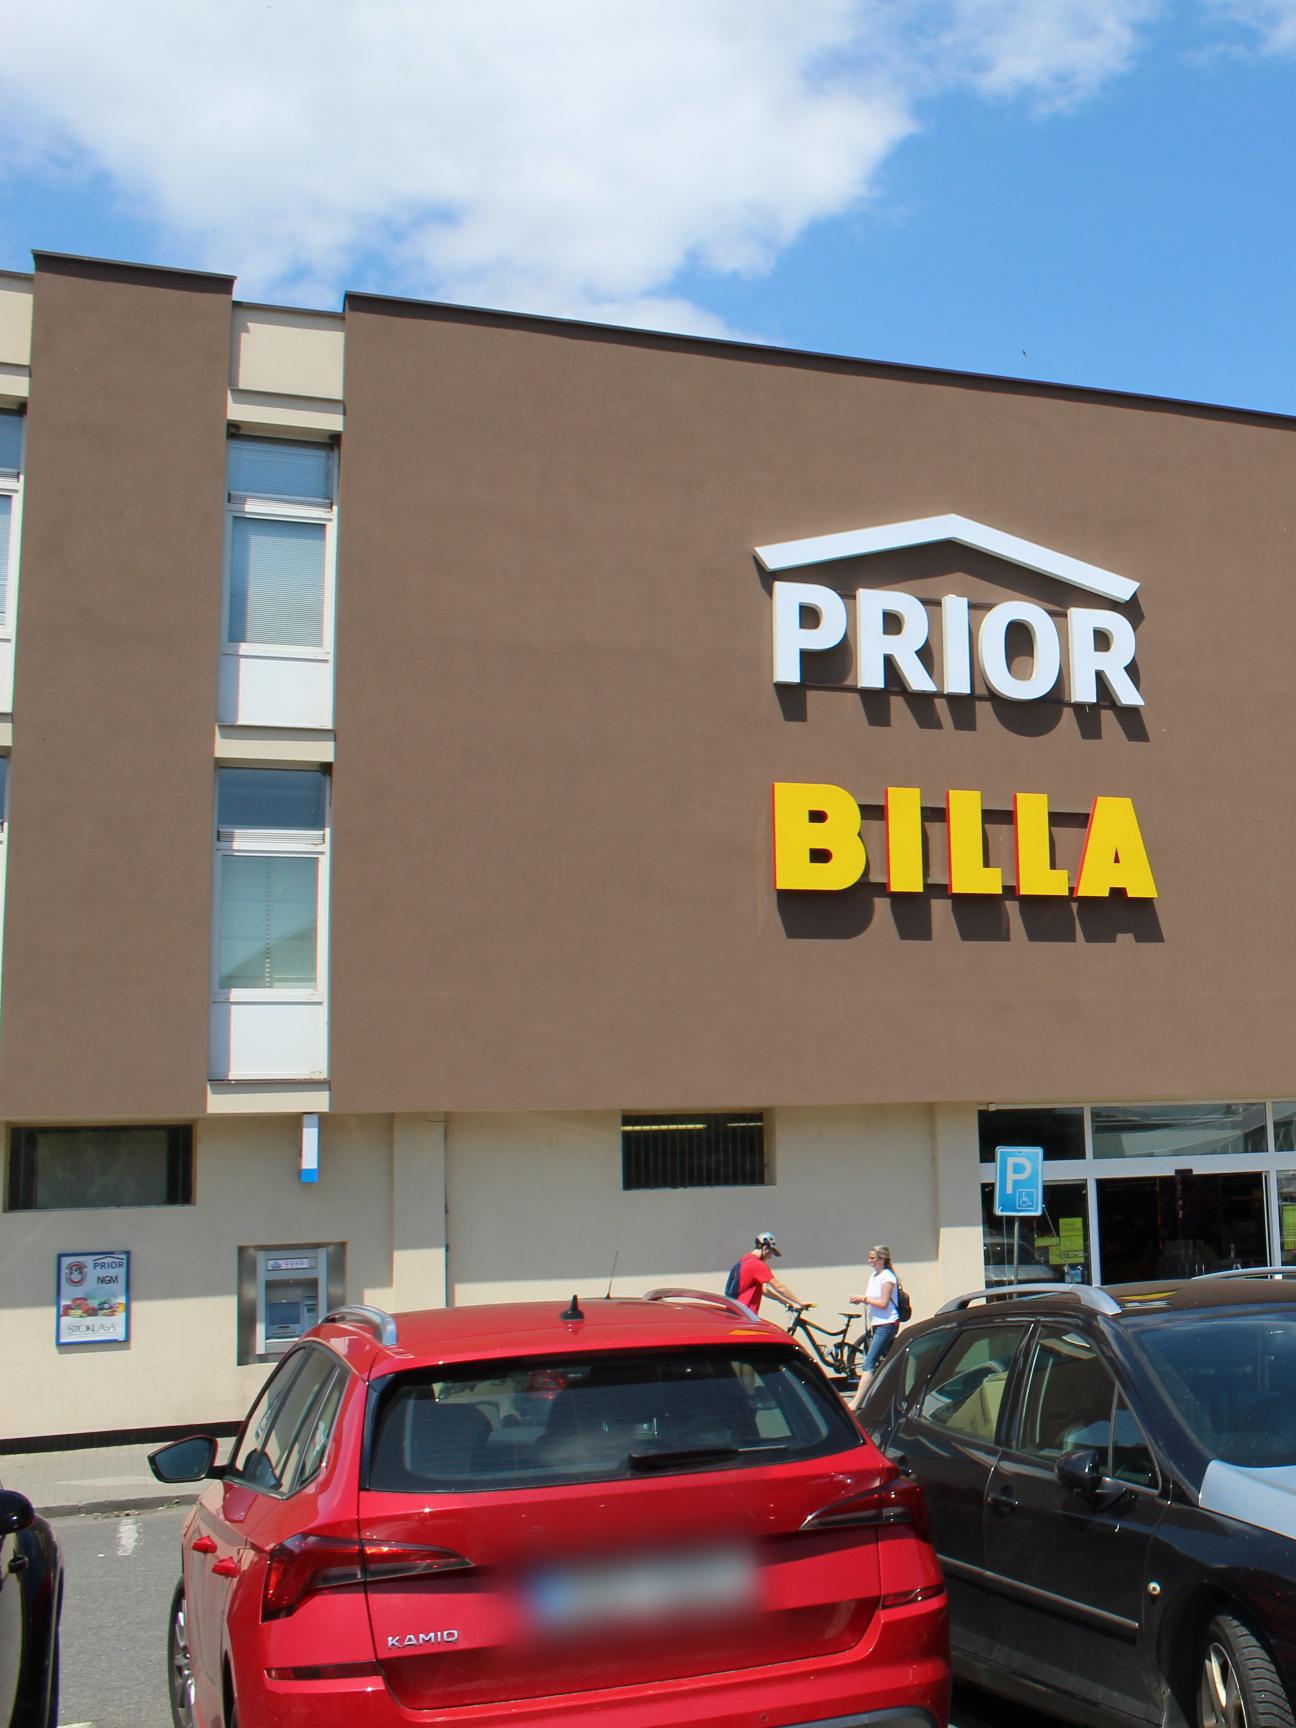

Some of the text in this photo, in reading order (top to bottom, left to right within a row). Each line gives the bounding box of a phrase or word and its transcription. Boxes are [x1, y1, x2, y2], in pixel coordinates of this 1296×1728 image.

[773, 581, 1146, 707] PRIOR
[772, 782, 1159, 899] BILLA
[1006, 1156, 1032, 1194] P
[93, 1260, 125, 1270] PRIOR
[96, 1275, 119, 1285] NGM
[387, 1629, 459, 1648] KAMIQ
